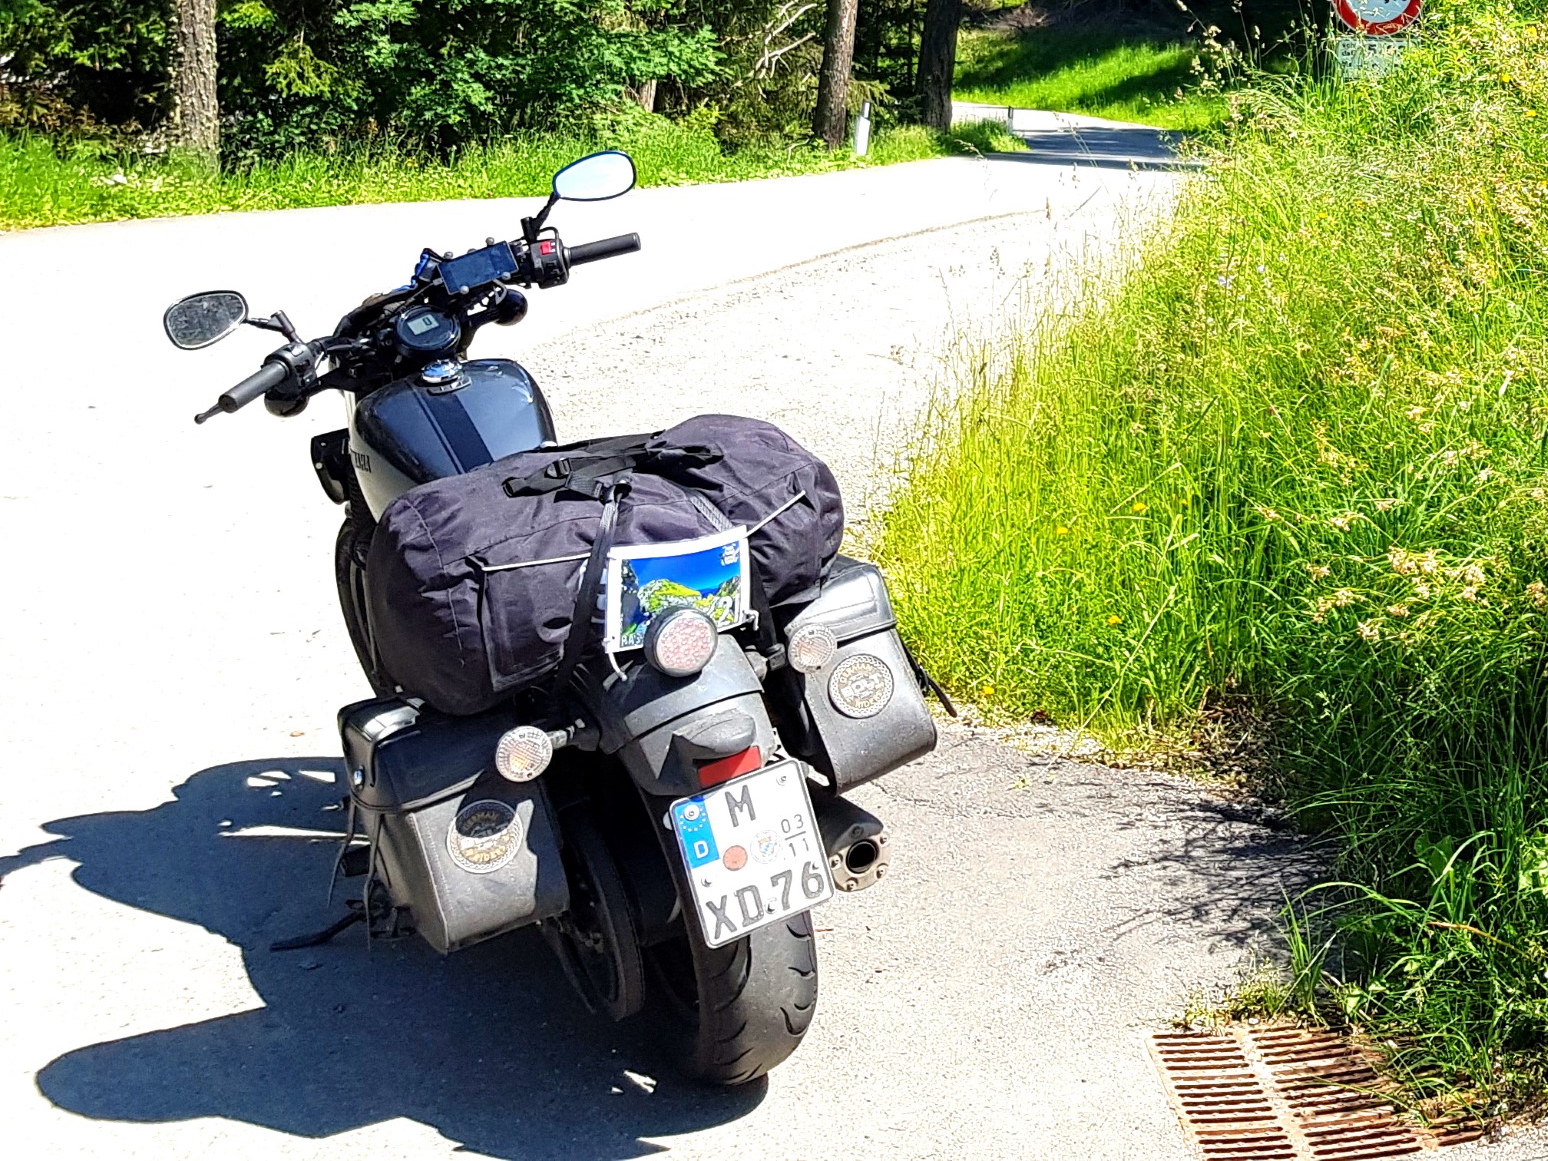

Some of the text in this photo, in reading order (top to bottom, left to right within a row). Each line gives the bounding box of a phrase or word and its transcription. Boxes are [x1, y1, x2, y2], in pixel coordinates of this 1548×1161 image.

[724, 784, 757, 828] M
[780, 813, 805, 834] 03
[693, 840, 710, 859] D
[705, 861, 825, 940] XD 76
